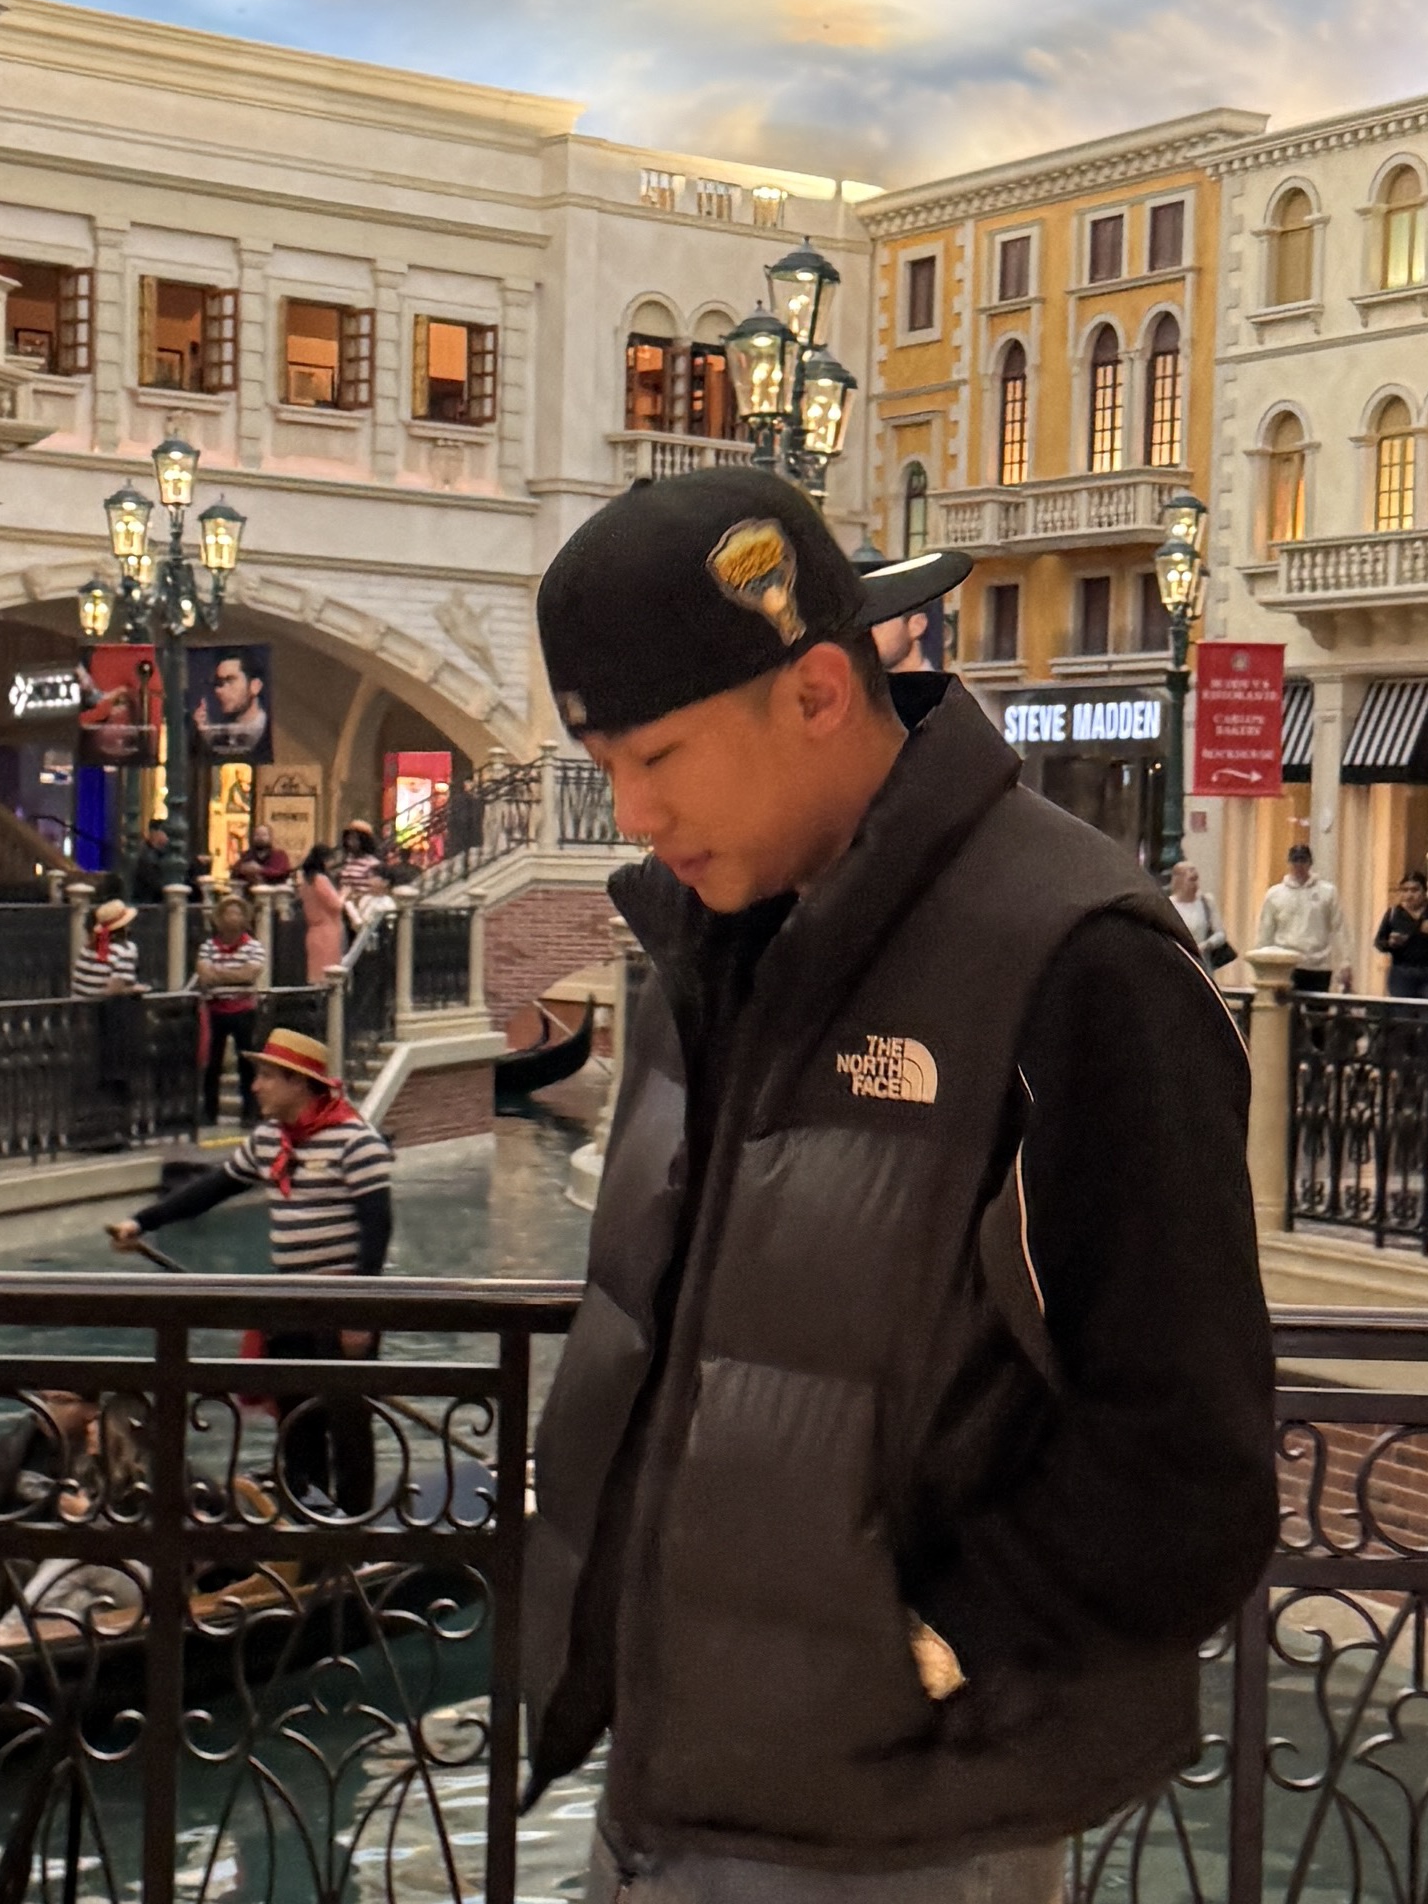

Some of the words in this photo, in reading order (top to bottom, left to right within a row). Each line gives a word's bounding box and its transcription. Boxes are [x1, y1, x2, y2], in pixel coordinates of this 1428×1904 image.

[1004, 704, 1067, 743] STEVE
[1072, 701, 1161, 740] MADDEN
[866, 1035, 904, 1058] THE
[836, 1053, 903, 1079] NORTH
[851, 1075, 903, 1100] FACE
